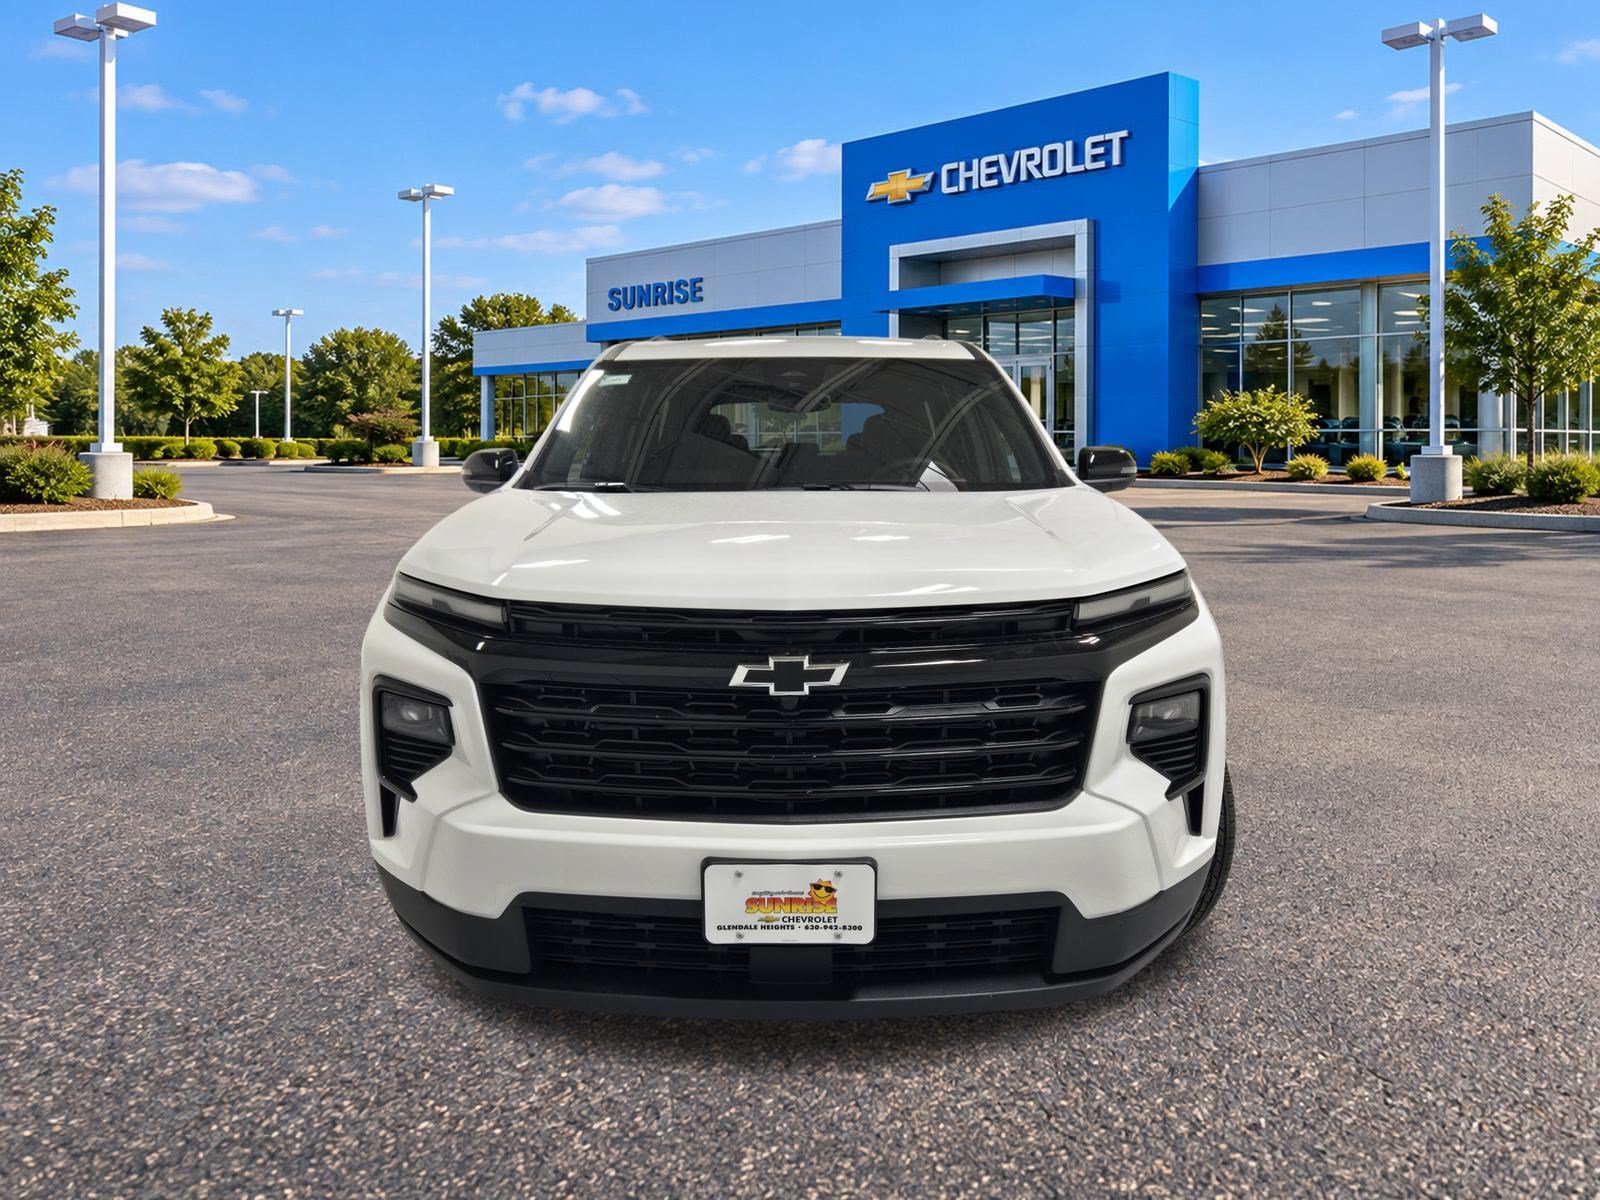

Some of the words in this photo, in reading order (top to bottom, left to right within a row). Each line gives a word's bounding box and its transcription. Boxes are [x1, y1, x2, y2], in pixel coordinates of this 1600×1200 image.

[941, 130, 1129, 194] CHEVROLET
[608, 277, 704, 312] SUNRISE
[745, 897, 838, 914] SUNRISE
[781, 916, 838, 924] CHEVROLET
